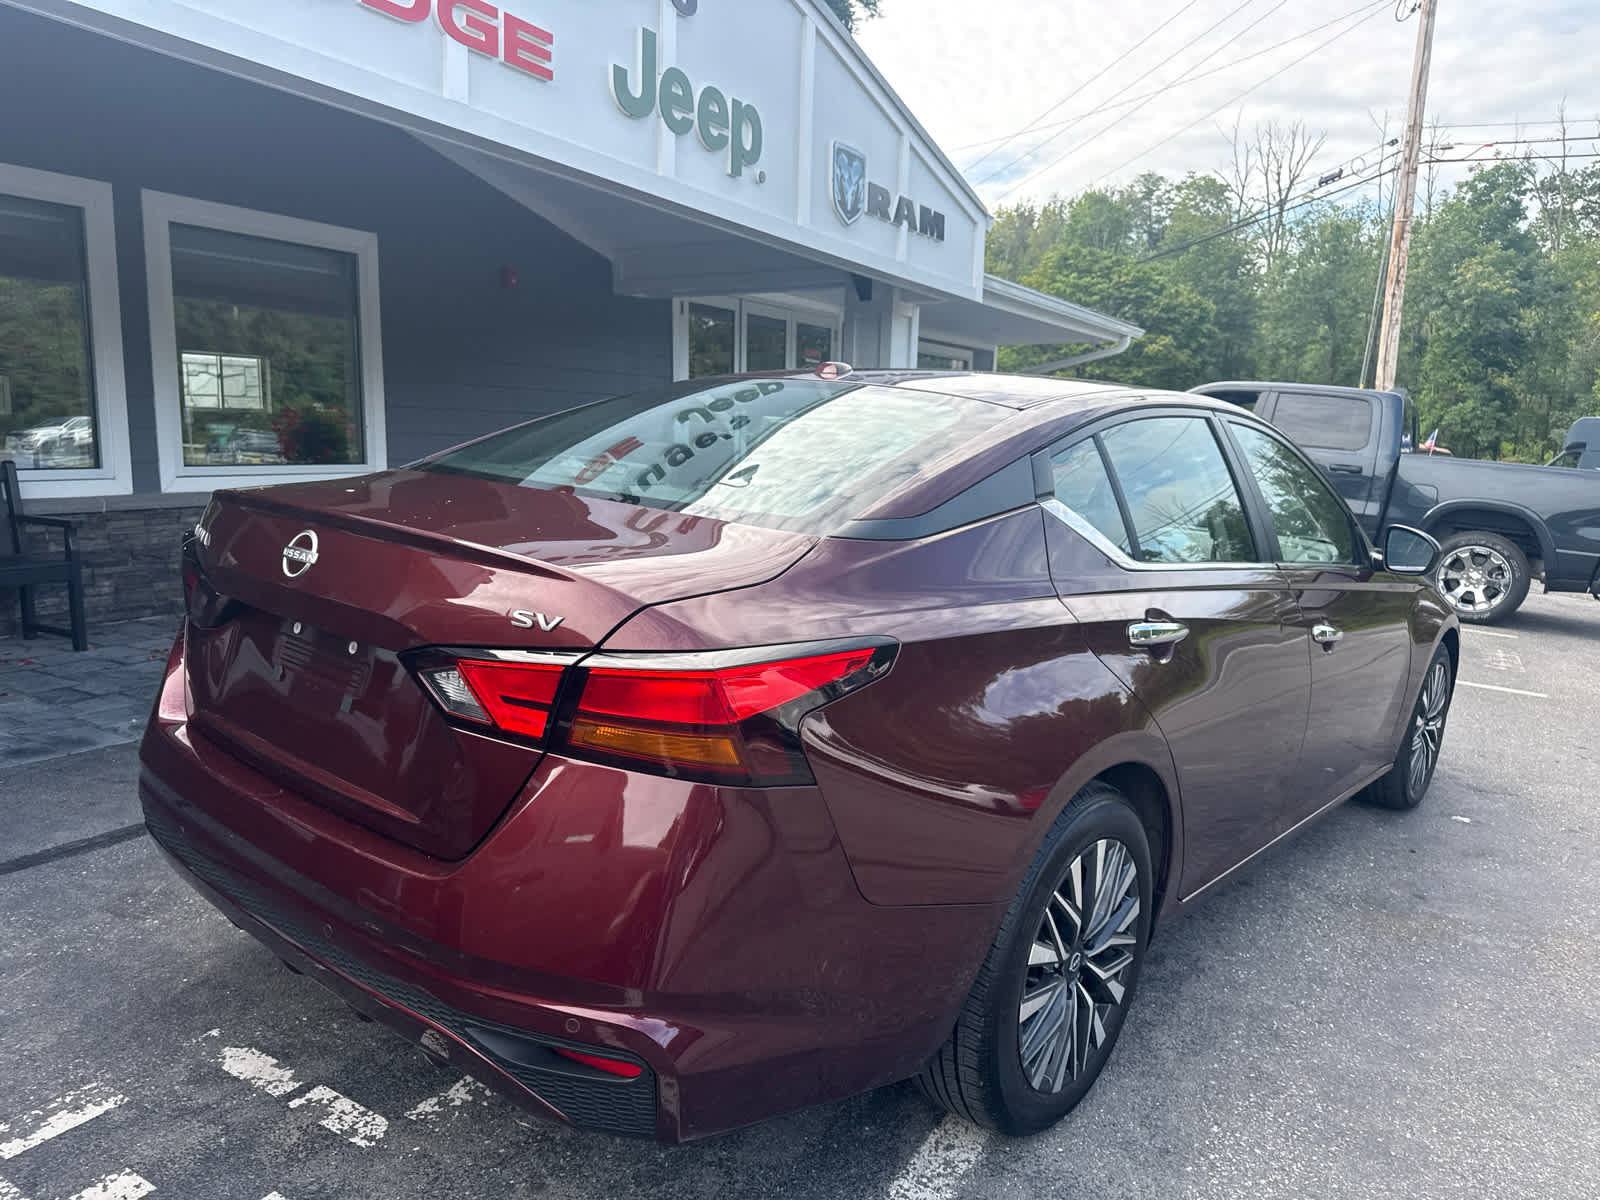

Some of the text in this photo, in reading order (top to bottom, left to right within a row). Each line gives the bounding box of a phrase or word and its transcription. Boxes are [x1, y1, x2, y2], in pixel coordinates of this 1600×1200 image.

[360, 0, 554, 81] GE
[609, 26, 763, 178] Jeep
[867, 181, 945, 241] RAM
[511, 609, 565, 632] SV
